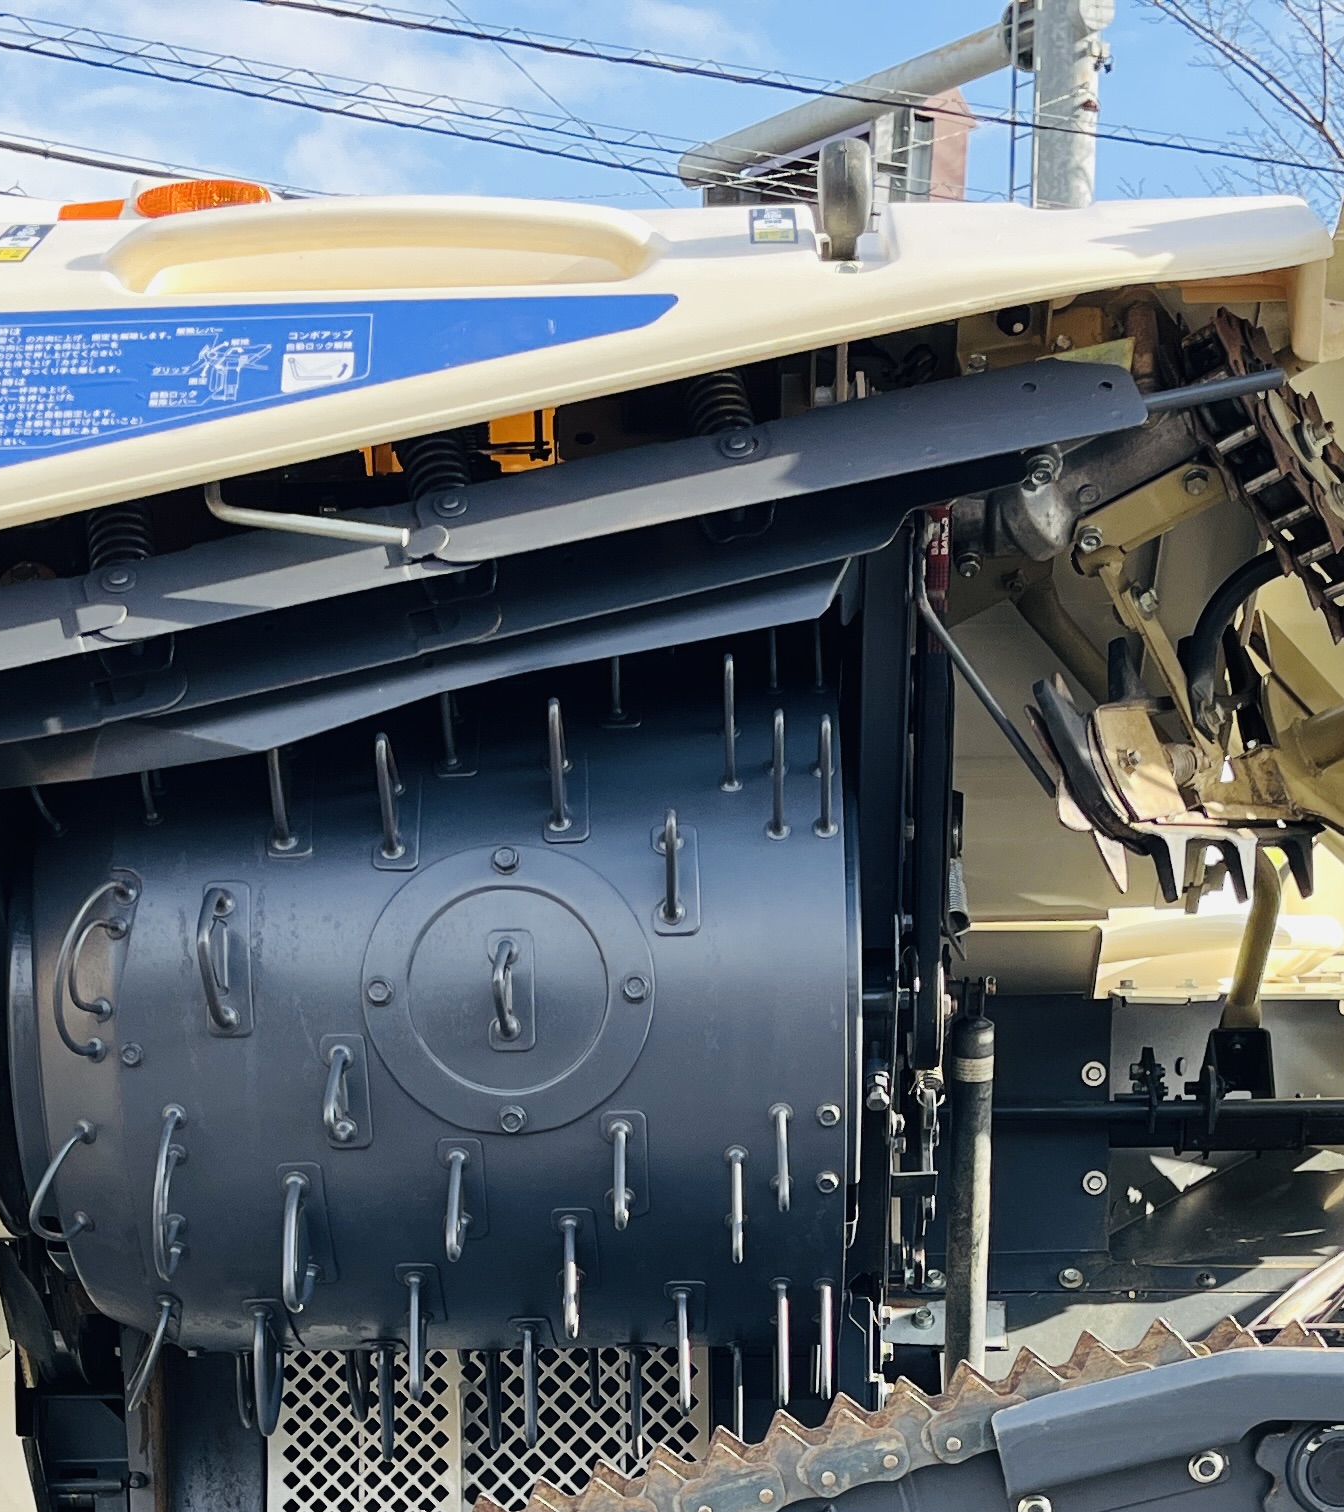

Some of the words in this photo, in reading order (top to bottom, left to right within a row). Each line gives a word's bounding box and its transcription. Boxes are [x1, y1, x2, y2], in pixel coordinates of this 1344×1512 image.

[288, 329, 353, 341] コンポアップ
